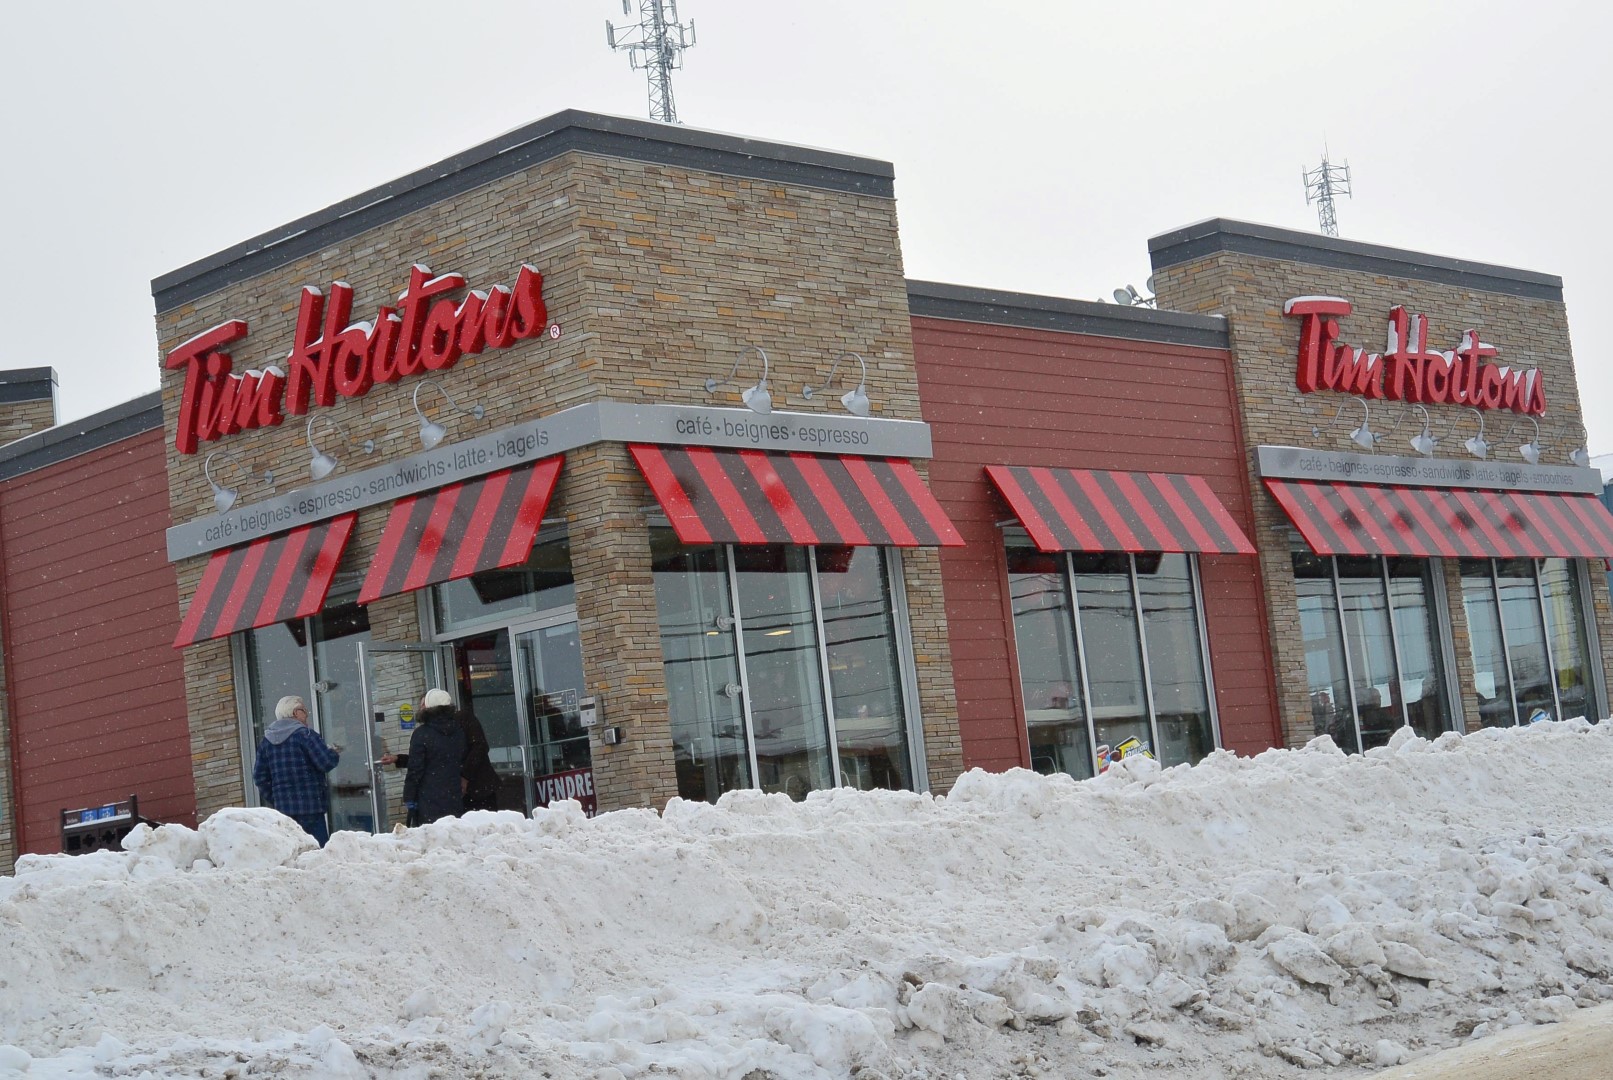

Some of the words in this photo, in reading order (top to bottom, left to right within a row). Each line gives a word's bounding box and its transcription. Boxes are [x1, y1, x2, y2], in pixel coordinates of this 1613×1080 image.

[166, 319, 286, 454] Tim
[285, 263, 548, 415] Hortons
[1283, 297, 1384, 399] Tim
[1385, 305, 1547, 416] Hortons
[676, 416, 713, 436] café
[723, 418, 789, 443] beignes
[798, 426, 869, 447] espresso
[205, 518, 232, 542] café
[240, 504, 292, 533] beignes
[299, 485, 361, 515] espresso
[369, 459, 446, 495] sandwichs
[453, 447, 487, 471] latte
[496, 428, 549, 458] bagels
[1300, 456, 1322, 472] café
[1329, 457, 1369, 477] beignes
[1373, 463, 1418, 479] espresso
[1422, 465, 1471, 480] sandwichs
[1475, 467, 1495, 482] latte
[1499, 468, 1529, 486] bagels
[536, 772, 594, 804] VENDRE
